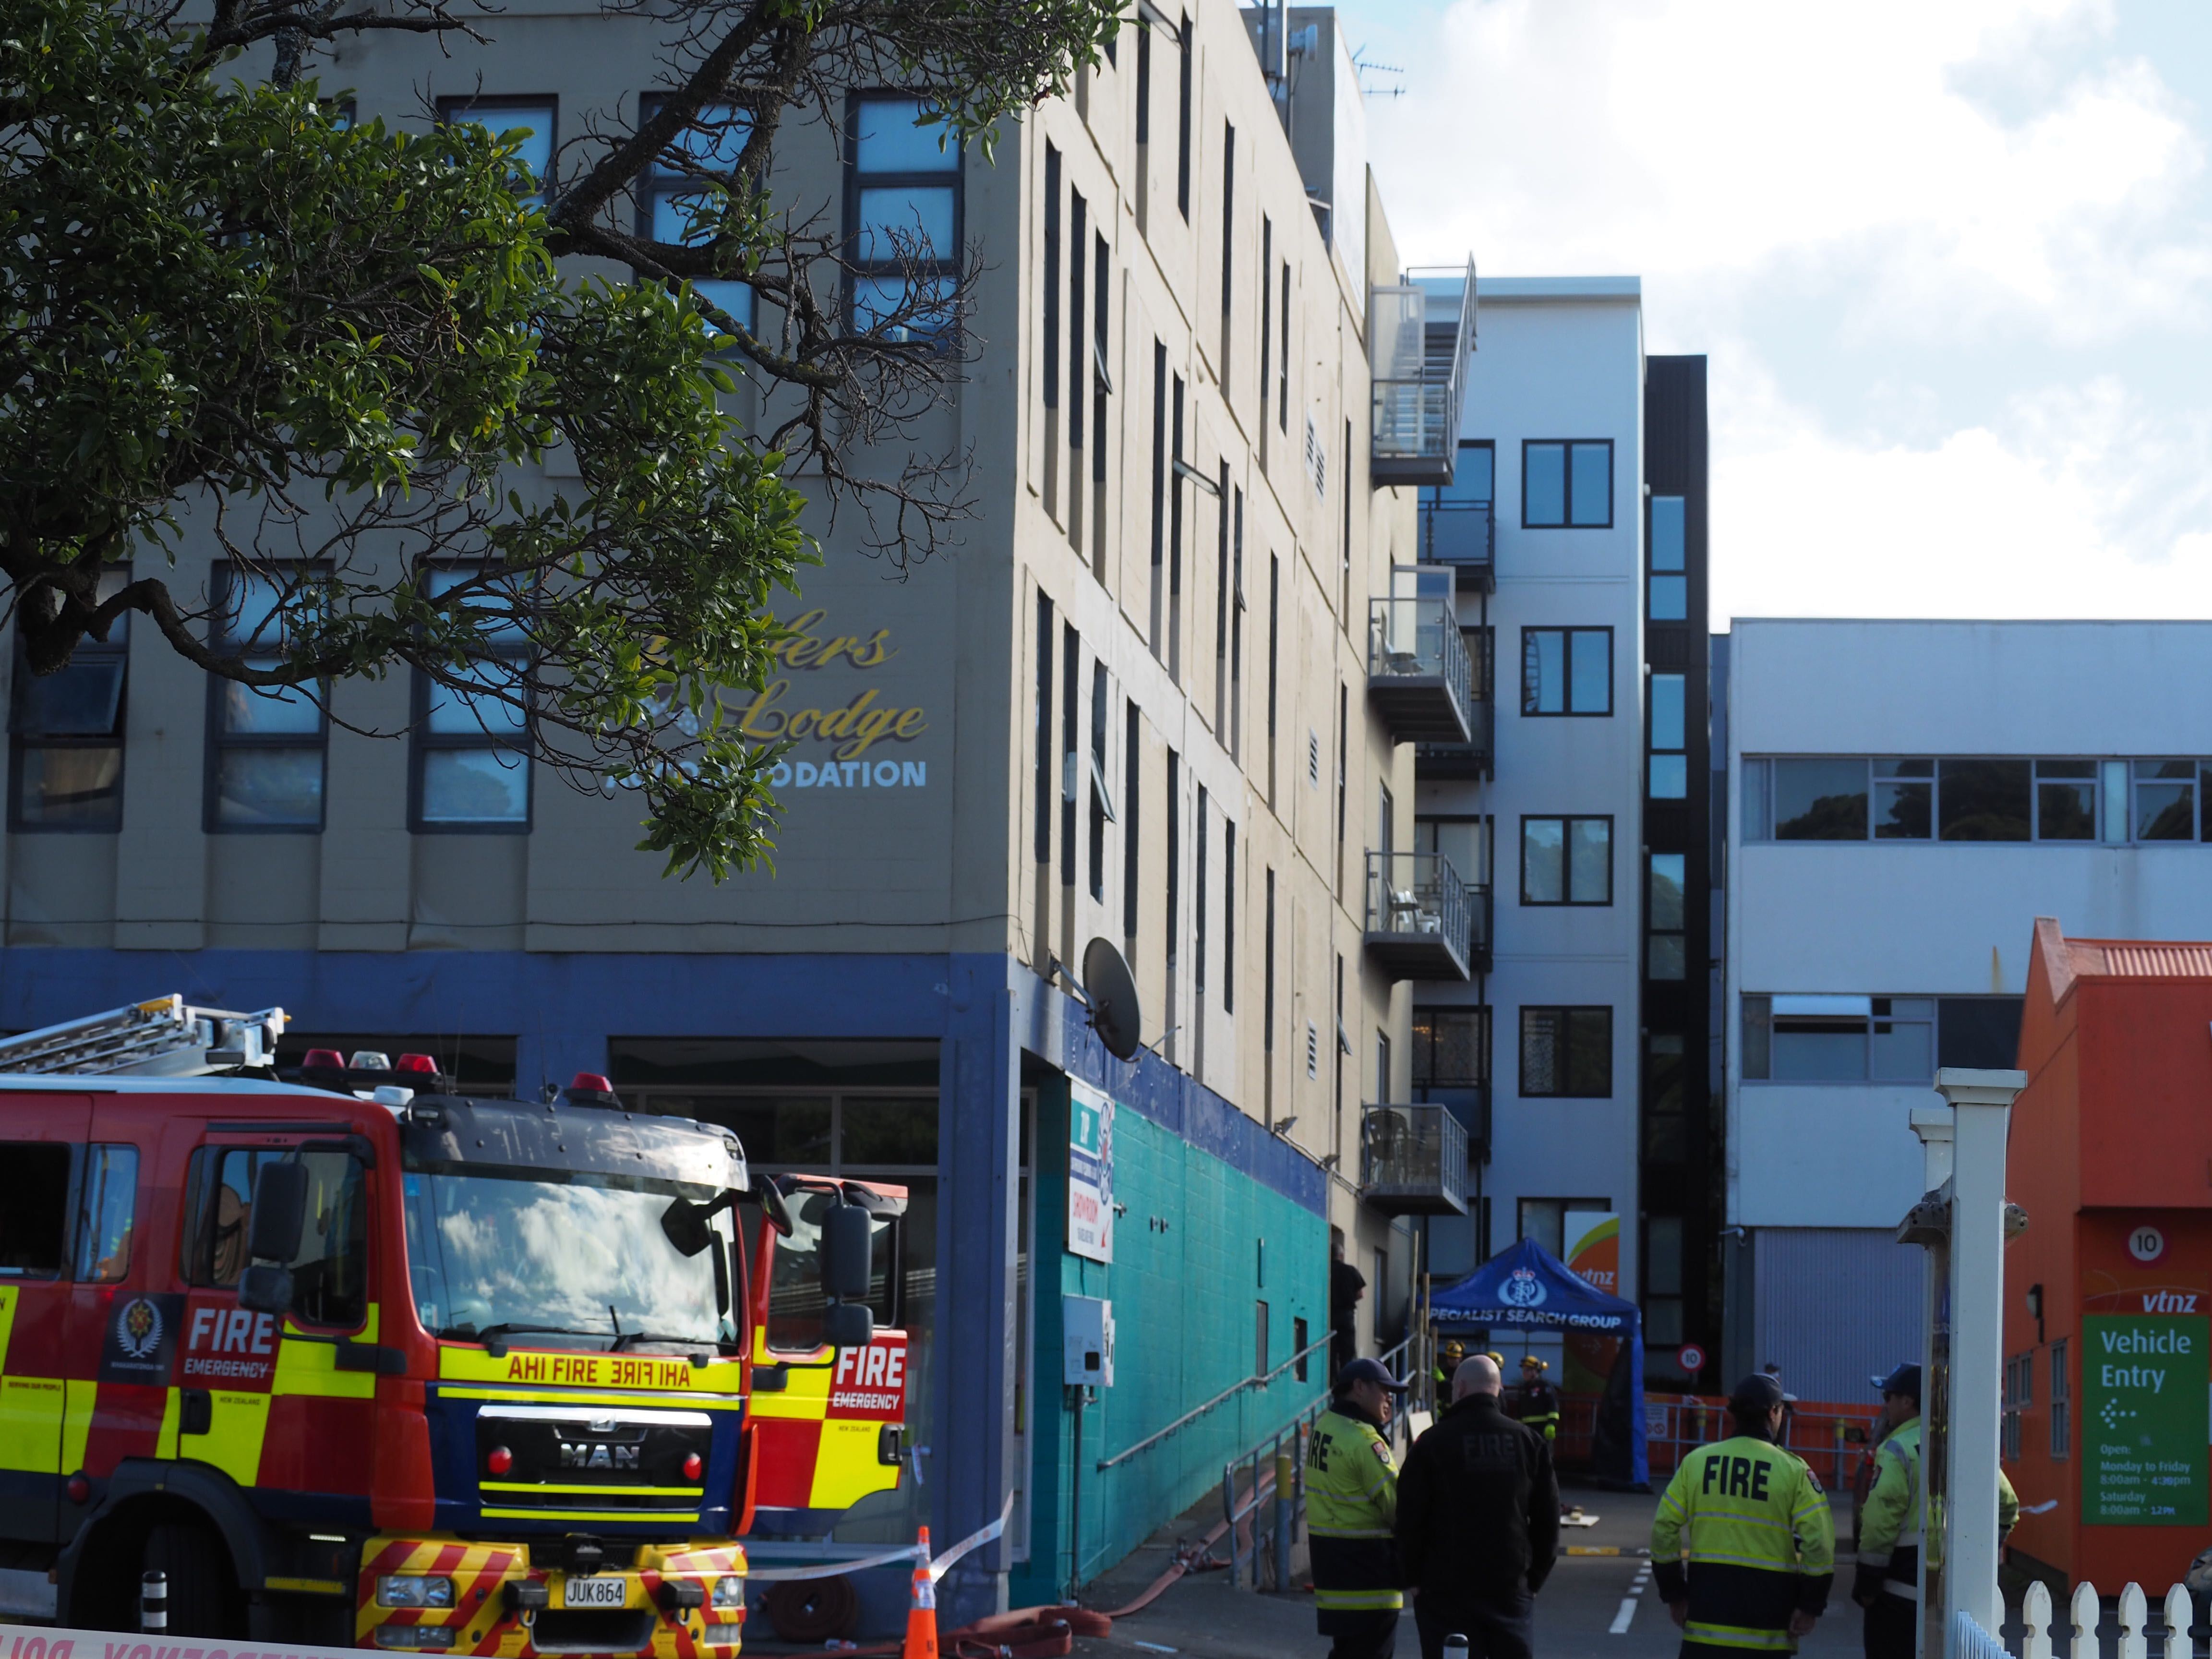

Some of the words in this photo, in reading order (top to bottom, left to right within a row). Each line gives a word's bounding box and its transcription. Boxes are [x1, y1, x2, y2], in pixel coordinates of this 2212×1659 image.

[712, 679, 929, 761] Lodge
[2137, 1234, 2157, 1252] 10
[2143, 1290, 2198, 1313] vtnz
[1428, 1308, 1506, 1321] PECIALIST
[1507, 1309, 1566, 1324] SEARCH
[1568, 1314, 1621, 1329] GROUP
[188, 1308, 274, 1354] FIRE
[2101, 1328, 2192, 1354] Vehicle
[184, 1358, 269, 1378] EMERGENCY
[508, 1356, 545, 1381] AHI
[553, 1358, 598, 1382] FIRE
[836, 1346, 906, 1388] FIRE
[1685, 1353, 1697, 1364] 10
[2102, 1364, 2165, 1394] Entry
[833, 1392, 900, 1410] EMERGENCY
[561, 1443, 640, 1469] MAN
[1306, 1431, 1333, 1473] IRE
[1463, 1433, 1515, 1458] FIRE
[2100, 1443, 2131, 1456] Open:
[2100, 1460, 2142, 1474] Monday
[2145, 1461, 2156, 1472] to
[2159, 1460, 2190, 1474] Friday
[1703, 1455, 1771, 1502] FIRE
[2100, 1474, 2140, 1485] 8:00am
[2100, 1491, 2146, 1504] Saturday
[2100, 1504, 2140, 1515] 8:00am
[567, 1583, 623, 1602] JUK864
